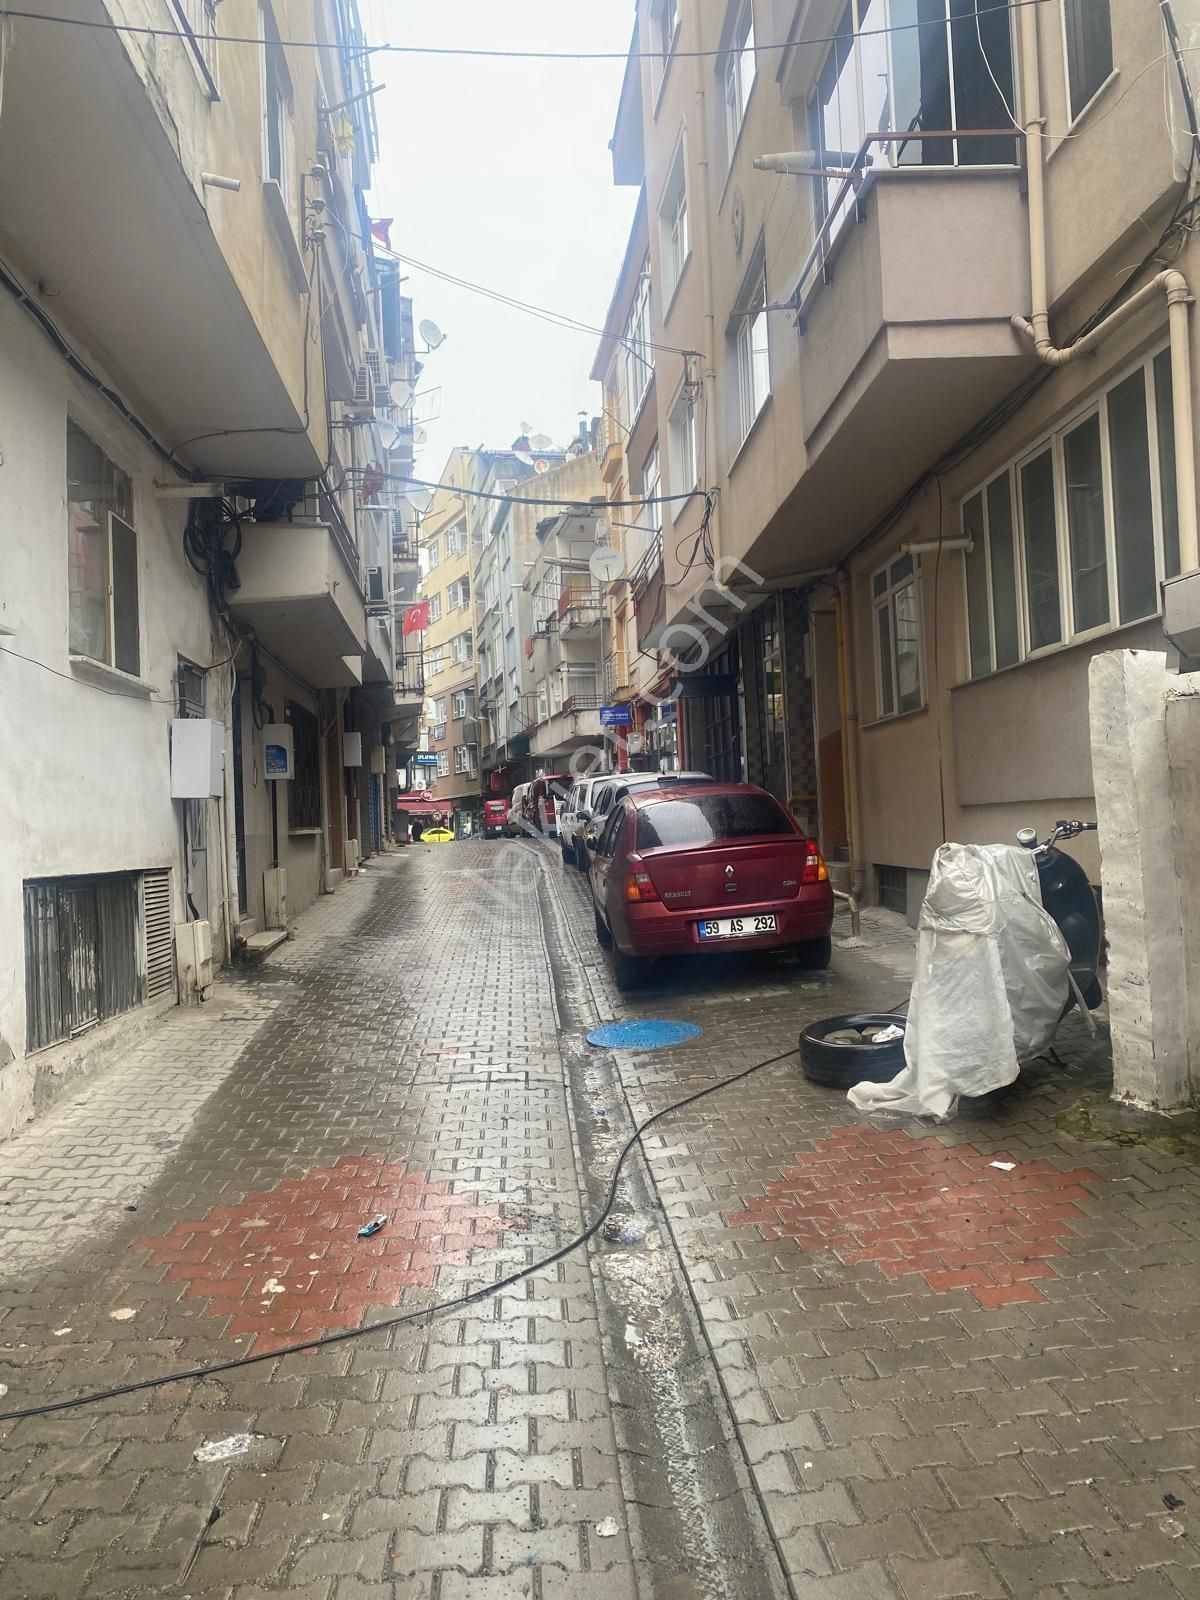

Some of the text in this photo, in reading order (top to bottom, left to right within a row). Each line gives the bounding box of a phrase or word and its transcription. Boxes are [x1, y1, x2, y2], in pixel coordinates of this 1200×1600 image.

[664, 890, 692, 898] RENAULT
[705, 916, 775, 935] 59 AS 292
